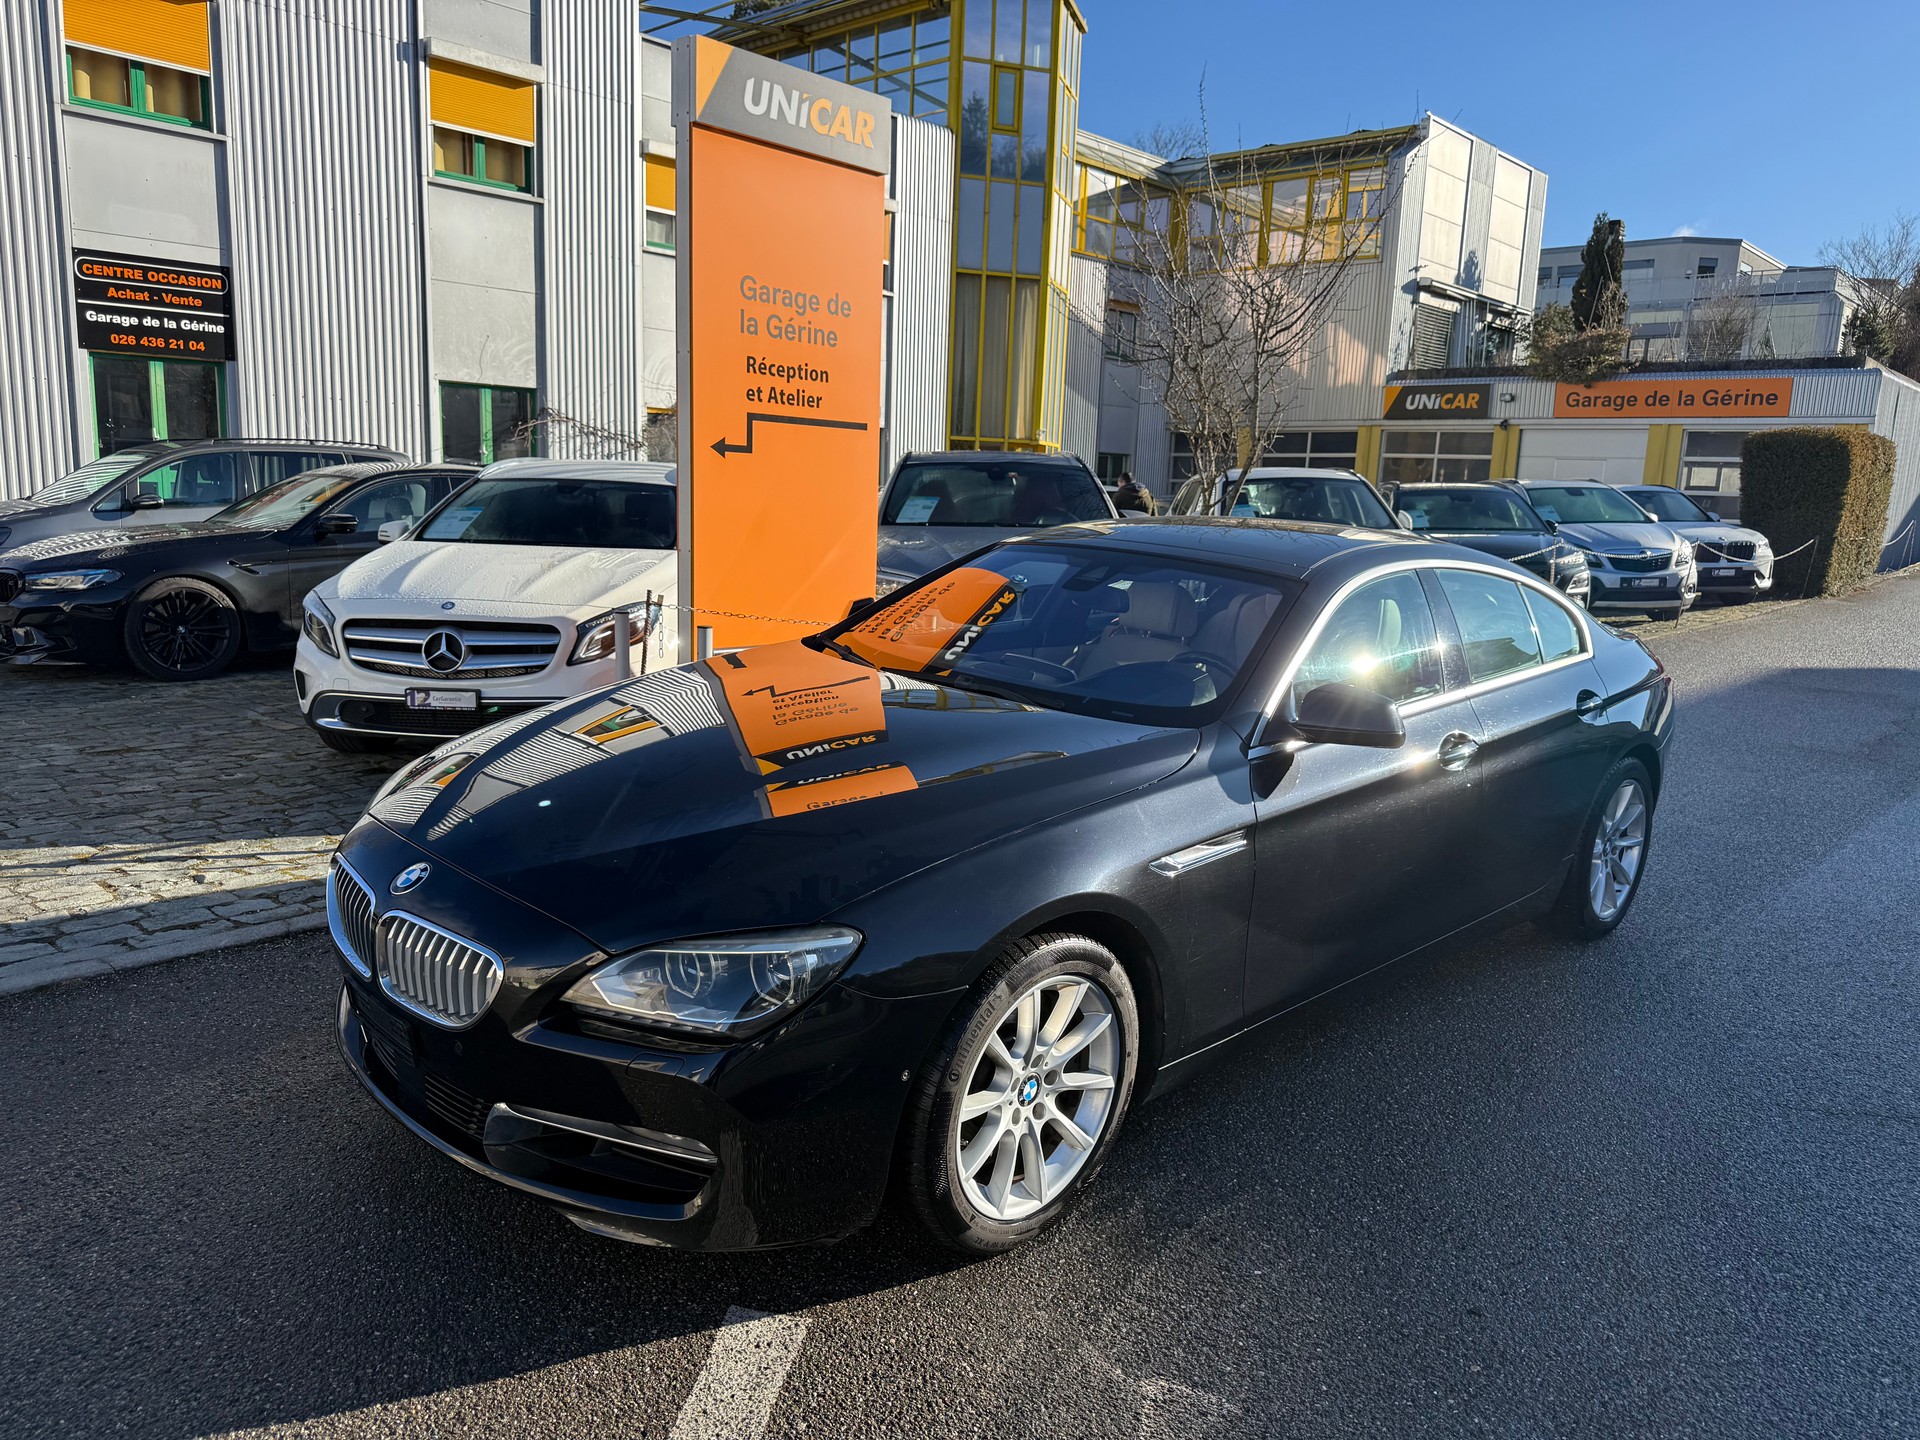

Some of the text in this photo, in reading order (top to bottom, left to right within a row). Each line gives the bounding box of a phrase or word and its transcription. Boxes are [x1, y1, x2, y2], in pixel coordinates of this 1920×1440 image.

[82, 263, 222, 290] CENTRE OCCASION
[107, 287, 150, 301] Achat
[161, 292, 203, 307] Vente
[739, 275, 852, 318] Garage de
[85, 310, 225, 334] Garage de la Gérine
[739, 308, 838, 348] la Gérine
[110, 334, 206, 352] 026 436 21 04
[746, 355, 829, 384] Réception
[746, 386, 823, 409] et Atelier
[1565, 388, 1779, 411] Garage de la Gérine
